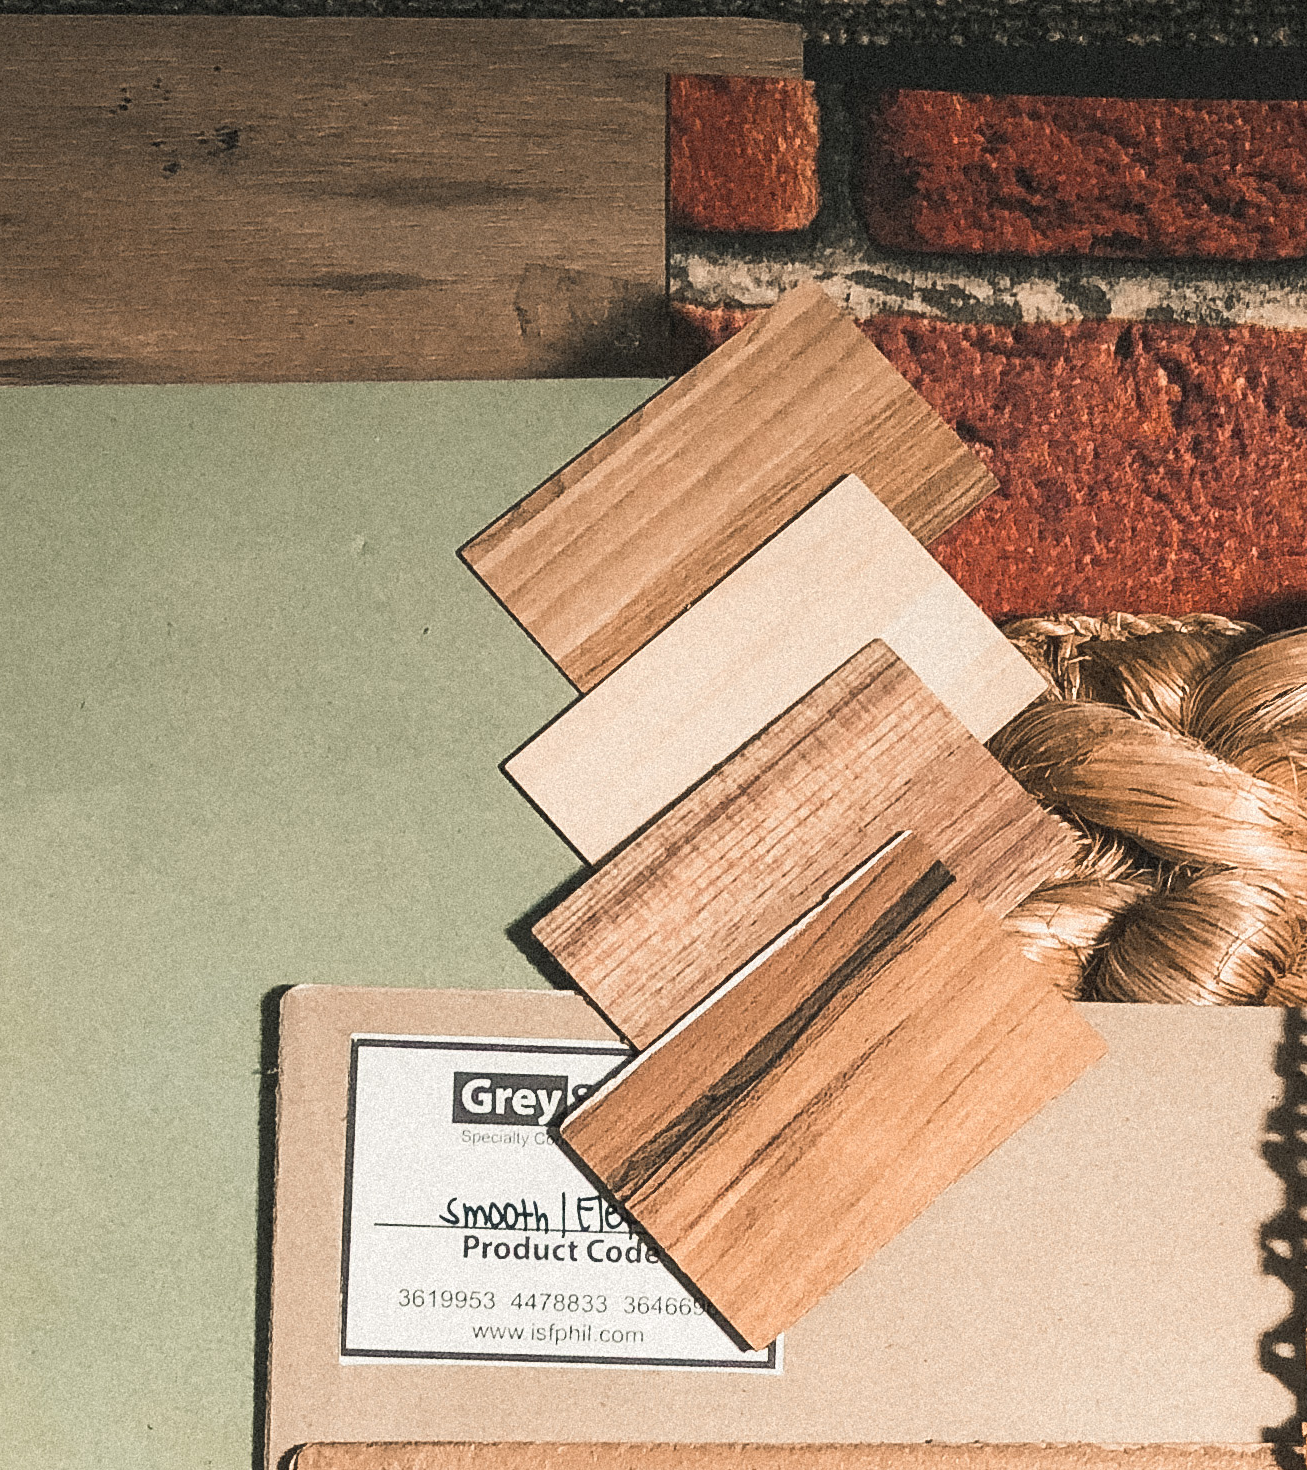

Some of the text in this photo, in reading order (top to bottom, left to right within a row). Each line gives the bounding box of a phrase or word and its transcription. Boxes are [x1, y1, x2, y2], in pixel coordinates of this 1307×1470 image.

[461, 1129, 530, 1148] Specialty
[462, 1234, 661, 1265] Product Code
[398, 1288, 496, 1310] 3619953
[510, 1291, 609, 1314] 4478833
[472, 1322, 645, 1346] www.isfphil.com
